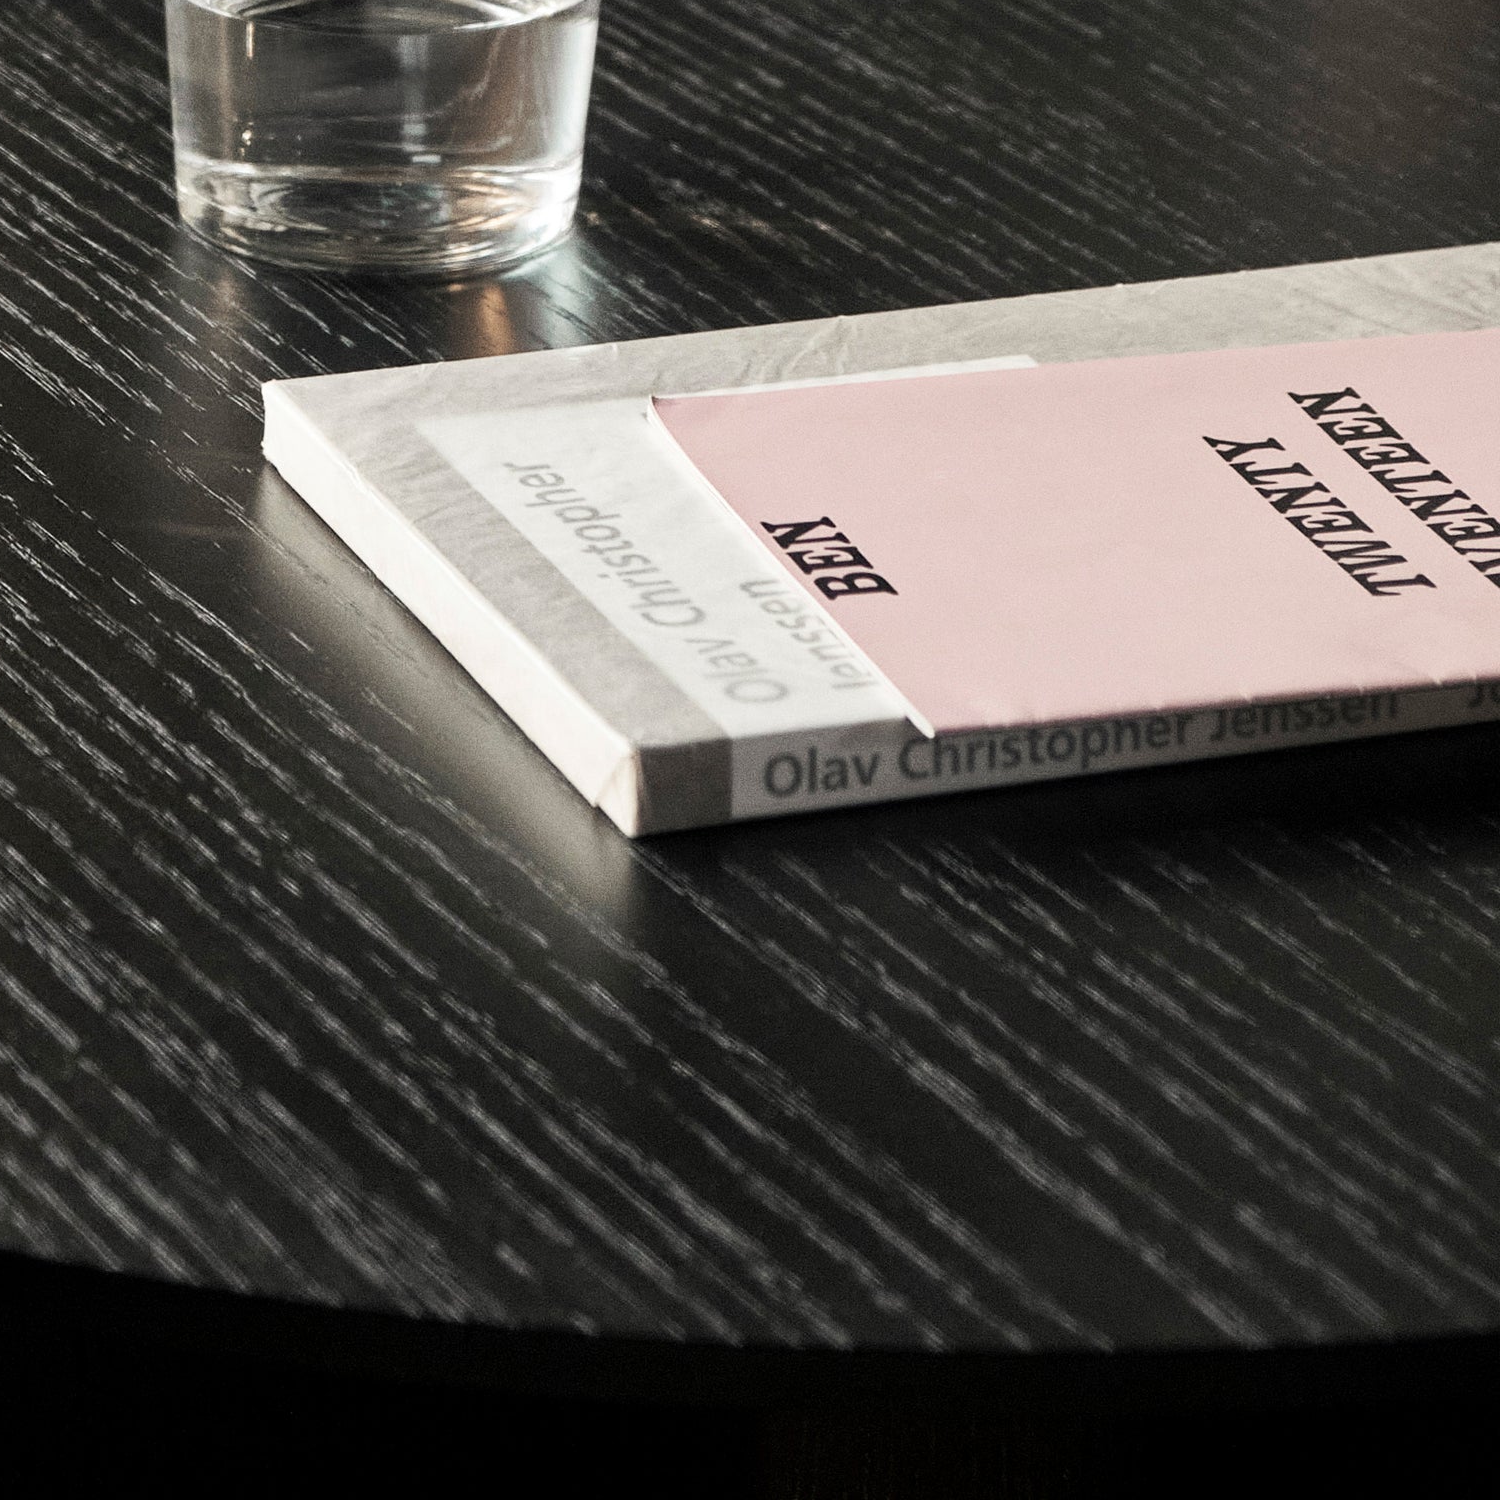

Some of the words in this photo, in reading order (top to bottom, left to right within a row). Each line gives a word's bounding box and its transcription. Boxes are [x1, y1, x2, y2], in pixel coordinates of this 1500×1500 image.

[503, 461, 706, 627] Christopher
[1202, 437, 1438, 596] TWENTY
[1287, 387, 1500, 590] VENTEEN
[760, 516, 899, 600] BEN
[685, 638, 790, 704] Olav
[763, 745, 881, 798] Olav
[897, 709, 1195, 780] Christopher
[1209, 692, 1398, 741] Jenssen
